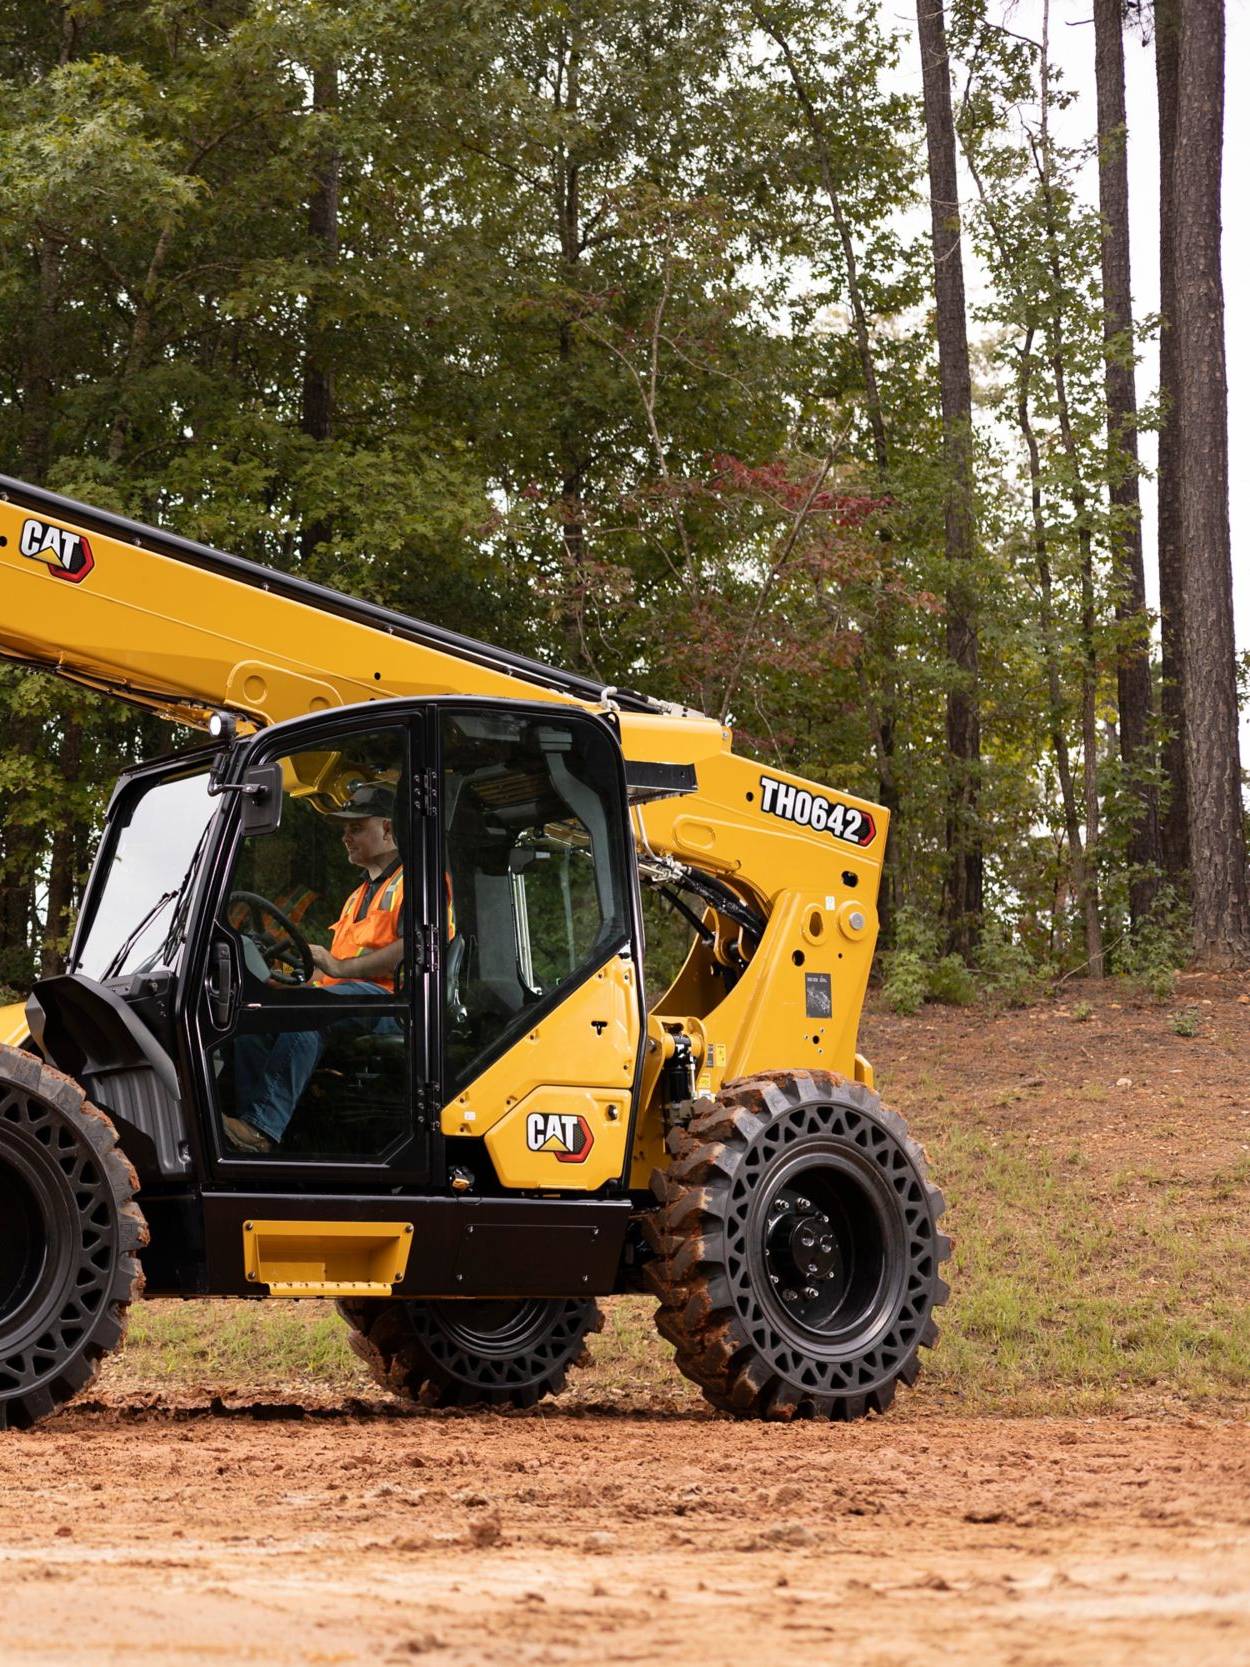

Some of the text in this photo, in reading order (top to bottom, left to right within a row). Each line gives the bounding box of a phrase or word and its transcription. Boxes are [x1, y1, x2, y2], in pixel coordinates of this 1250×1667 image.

[20, 519, 80, 570] CAT
[760, 777, 863, 843] TH0642
[527, 1113, 578, 1152] CAT
